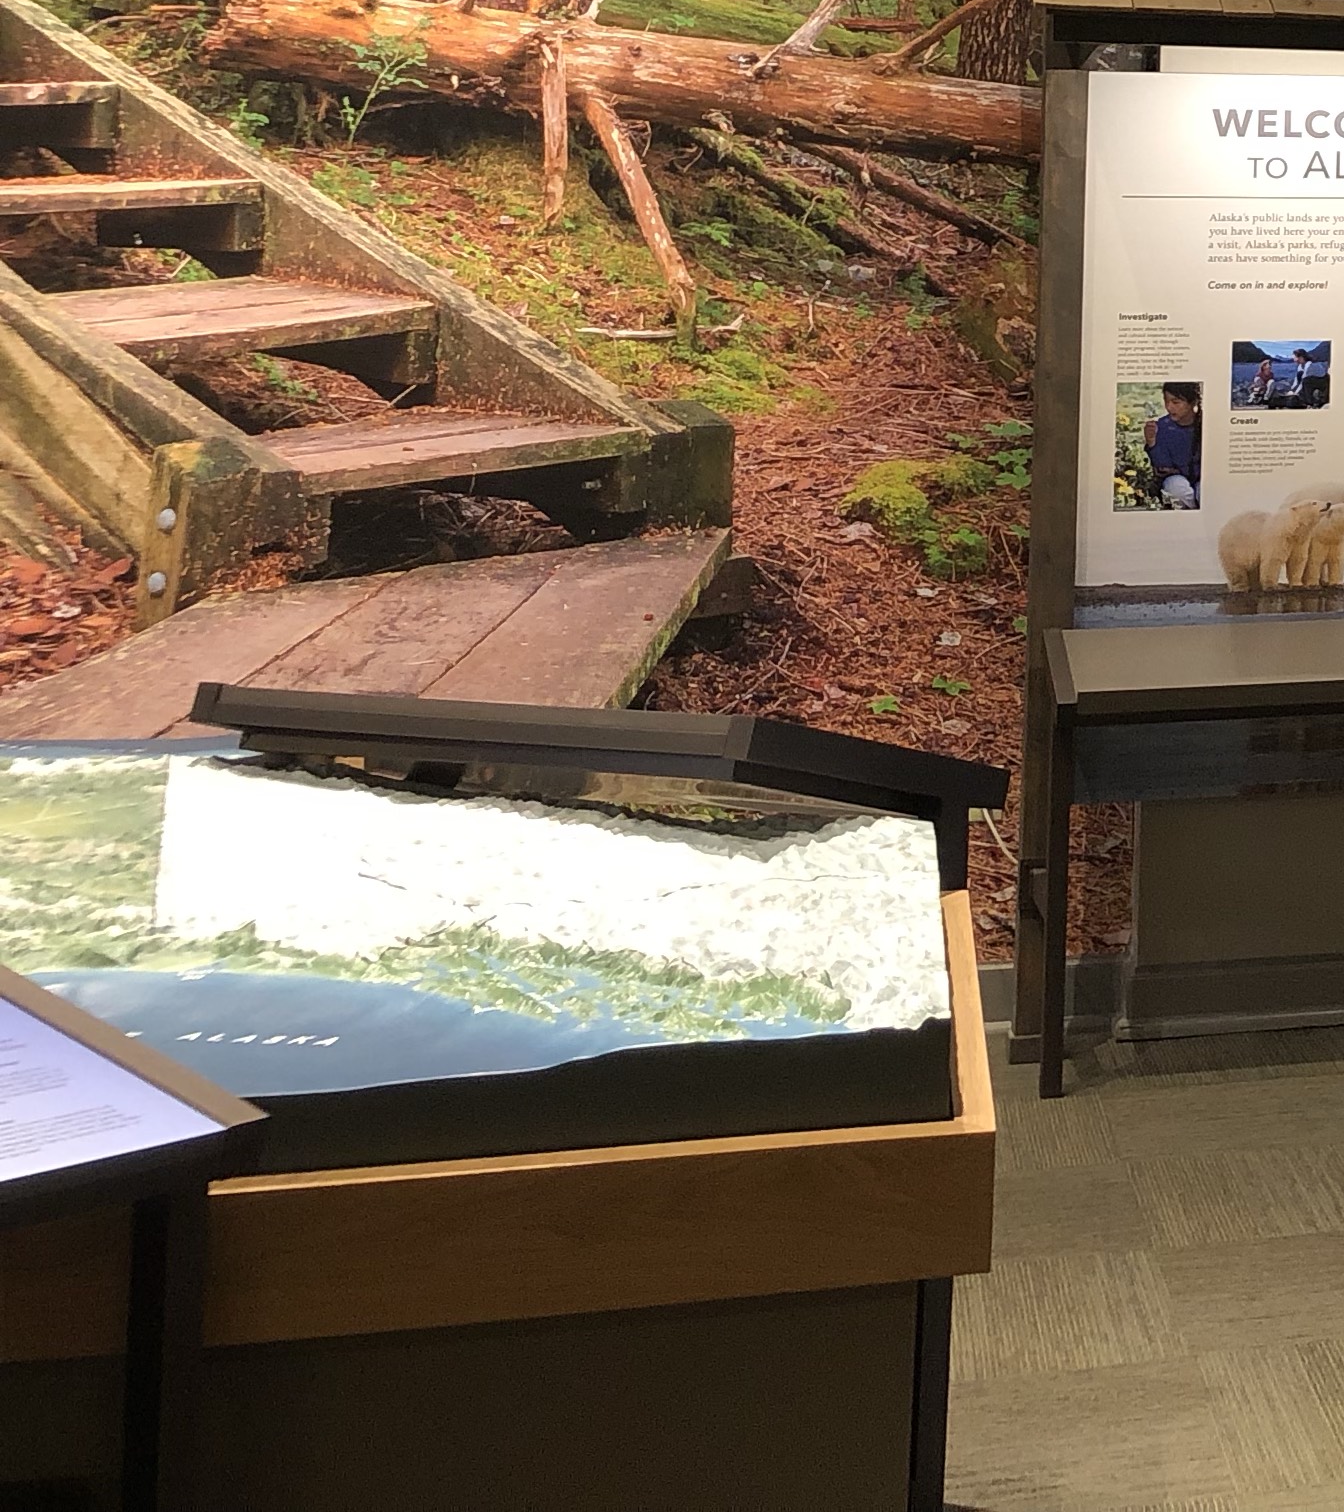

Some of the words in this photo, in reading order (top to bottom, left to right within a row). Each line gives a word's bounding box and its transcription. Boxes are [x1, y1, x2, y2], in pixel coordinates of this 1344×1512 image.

[1247, 158, 1288, 179] TO
[1209, 213, 1249, 222] Alaska's
[1252, 213, 1283, 225] public
[1287, 213, 1312, 222] lands
[1208, 229, 1227, 238] you
[1230, 226, 1253, 235] have
[1256, 226, 1280, 235] lived
[1283, 227, 1305, 235] here
[1307, 229, 1330, 239] your
[1217, 240, 1241, 249] visit,
[1245, 240, 1285, 249] Alaska's
[1288, 240, 1317, 252] parks,
[1236, 253, 1258, 262] have
[1261, 253, 1312, 265] something
[1315, 253, 1329, 262] for
[1208, 281, 1237, 289] Come
[1255, 281, 1264, 289] in
[1266, 280, 1286, 289] and
[1288, 280, 1328, 291] explore!
[1119, 313, 1168, 322] Investigate
[175, 1031, 340, 1047] ALASKA
